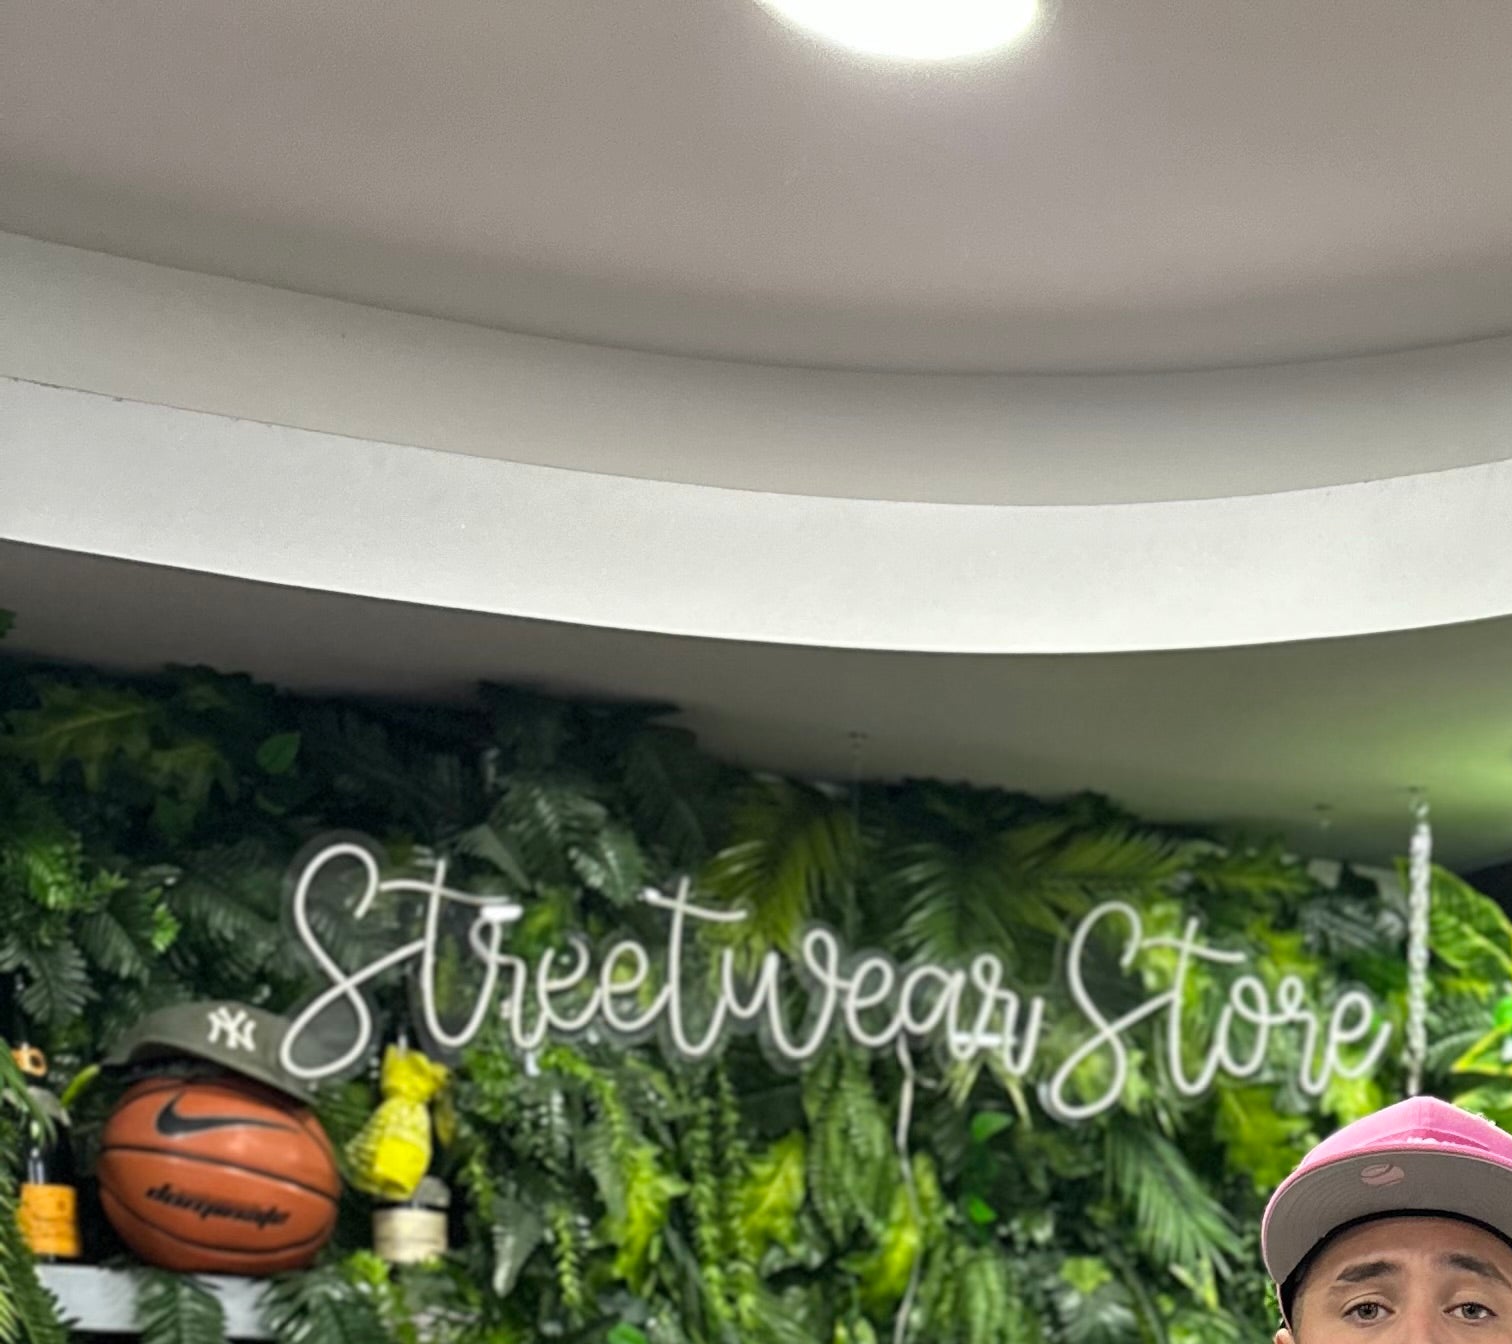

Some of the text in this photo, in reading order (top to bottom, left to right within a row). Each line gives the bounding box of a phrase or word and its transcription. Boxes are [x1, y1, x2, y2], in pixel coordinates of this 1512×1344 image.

[207, 1006, 257, 1052] NY
[280, 843, 1391, 1120] Streetwear Store
